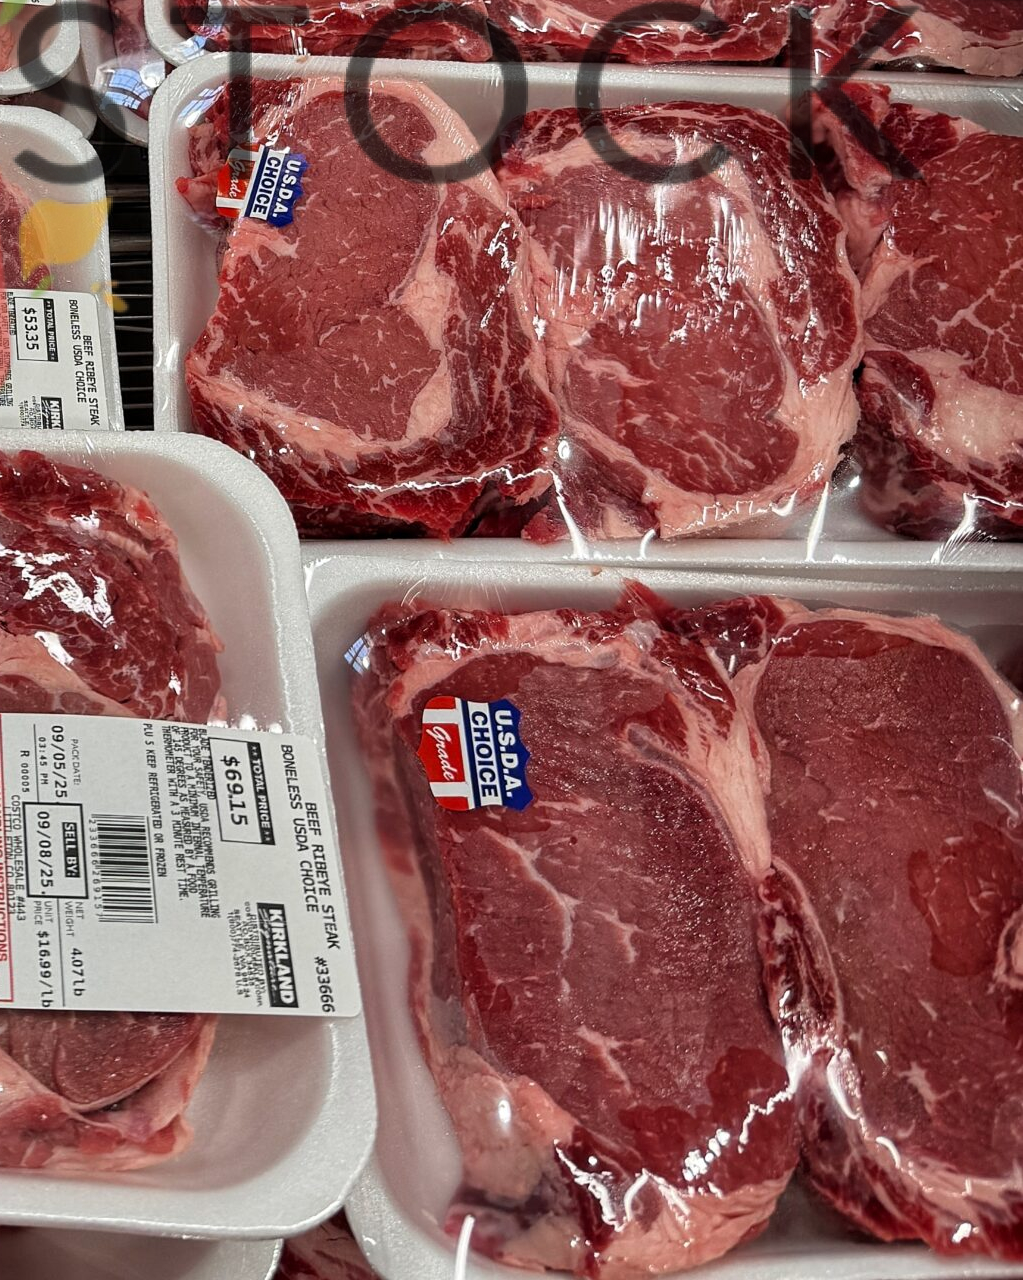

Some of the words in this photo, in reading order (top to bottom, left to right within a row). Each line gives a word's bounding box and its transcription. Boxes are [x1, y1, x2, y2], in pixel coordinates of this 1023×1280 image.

[253, 157, 282, 215] CHOICE
[273, 160, 302, 218] U.S.D.A.
[22, 307, 39, 350] $53.35
[68, 299, 81, 340] BONELESS
[47, 331, 55, 352] PRICE
[72, 344, 83, 366] USDA
[82, 334, 94, 356] BEEF
[75, 370, 87, 403] CHOICE
[85, 360, 97, 393] RIBEYE
[88, 397, 100, 426] STEAK
[142, 723, 154, 737] PLU
[172, 738, 183, 752] 145
[180, 726, 193, 758] PRODUCT
[188, 727, 200, 741] FOR
[197, 728, 210, 751] BLADE
[38, 736, 48, 766] 03:45
[70, 738, 80, 760] PACK
[145, 749, 157, 768] KEEP
[162, 725, 176, 774] THERMOMETER
[191, 745, 202, 764] YOUR
[426, 725, 458, 781] Grade
[471, 711, 499, 798] CHOICE
[495, 710, 522, 798] U.S.D.A.
[20, 762, 30, 793] 00005
[40, 772, 49, 785] PM
[72, 761, 82, 785] DATE:
[174, 756, 187, 788] DEGREES
[184, 761, 194, 771] TO
[193, 766, 206, 797] SAFETY,
[202, 755, 215, 800] TENDERIZED
[251, 758, 265, 793] TOTAL
[280, 744, 303, 809] BONELESS
[148, 772, 162, 829] REFRIGERATED
[167, 777, 178, 797] WITH
[178, 792, 188, 802] AS
[187, 783, 199, 817] MINIMUM
[221, 755, 248, 825] $69.15
[10, 794, 22, 830] COSTCO
[180, 806, 193, 845] MEASURED
[198, 802, 209, 822] USDA
[256, 794, 270, 828] PRICE
[304, 802, 322, 836] BEEF
[63, 822, 76, 853] SELL
[153, 832, 164, 843] OR
[172, 819, 184, 849] MINUTE
[201, 826, 215, 874] RECOMMENDS
[292, 817, 309, 852] USDA
[13, 835, 25, 890] WHOLESALE
[65, 856, 77, 877] BY:
[155, 847, 167, 877] FROZEN
[175, 853, 186, 873] REST
[184, 848, 195, 860] BY
[311, 844, 331, 896] RIBEYE
[177, 878, 189, 901] TIME.
[186, 873, 198, 894] FOOD
[195, 864, 211, 918] TEMPERATURE
[206, 878, 220, 918] GRILLING
[299, 860, 319, 912] CHOICE
[16, 895, 26, 921] #443
[33, 900, 43, 925] PRICE
[43, 900, 54, 923] UNIT
[64, 900, 75, 937] WEIGHT
[75, 901, 85, 920] NET
[321, 904, 340, 949] STEAK
[37, 930, 53, 1008] $16.99/lb
[71, 947, 85, 996] 4.07lb
[268, 908, 294, 1004] KIRKLAND
[314, 956, 335, 1013] #33666
